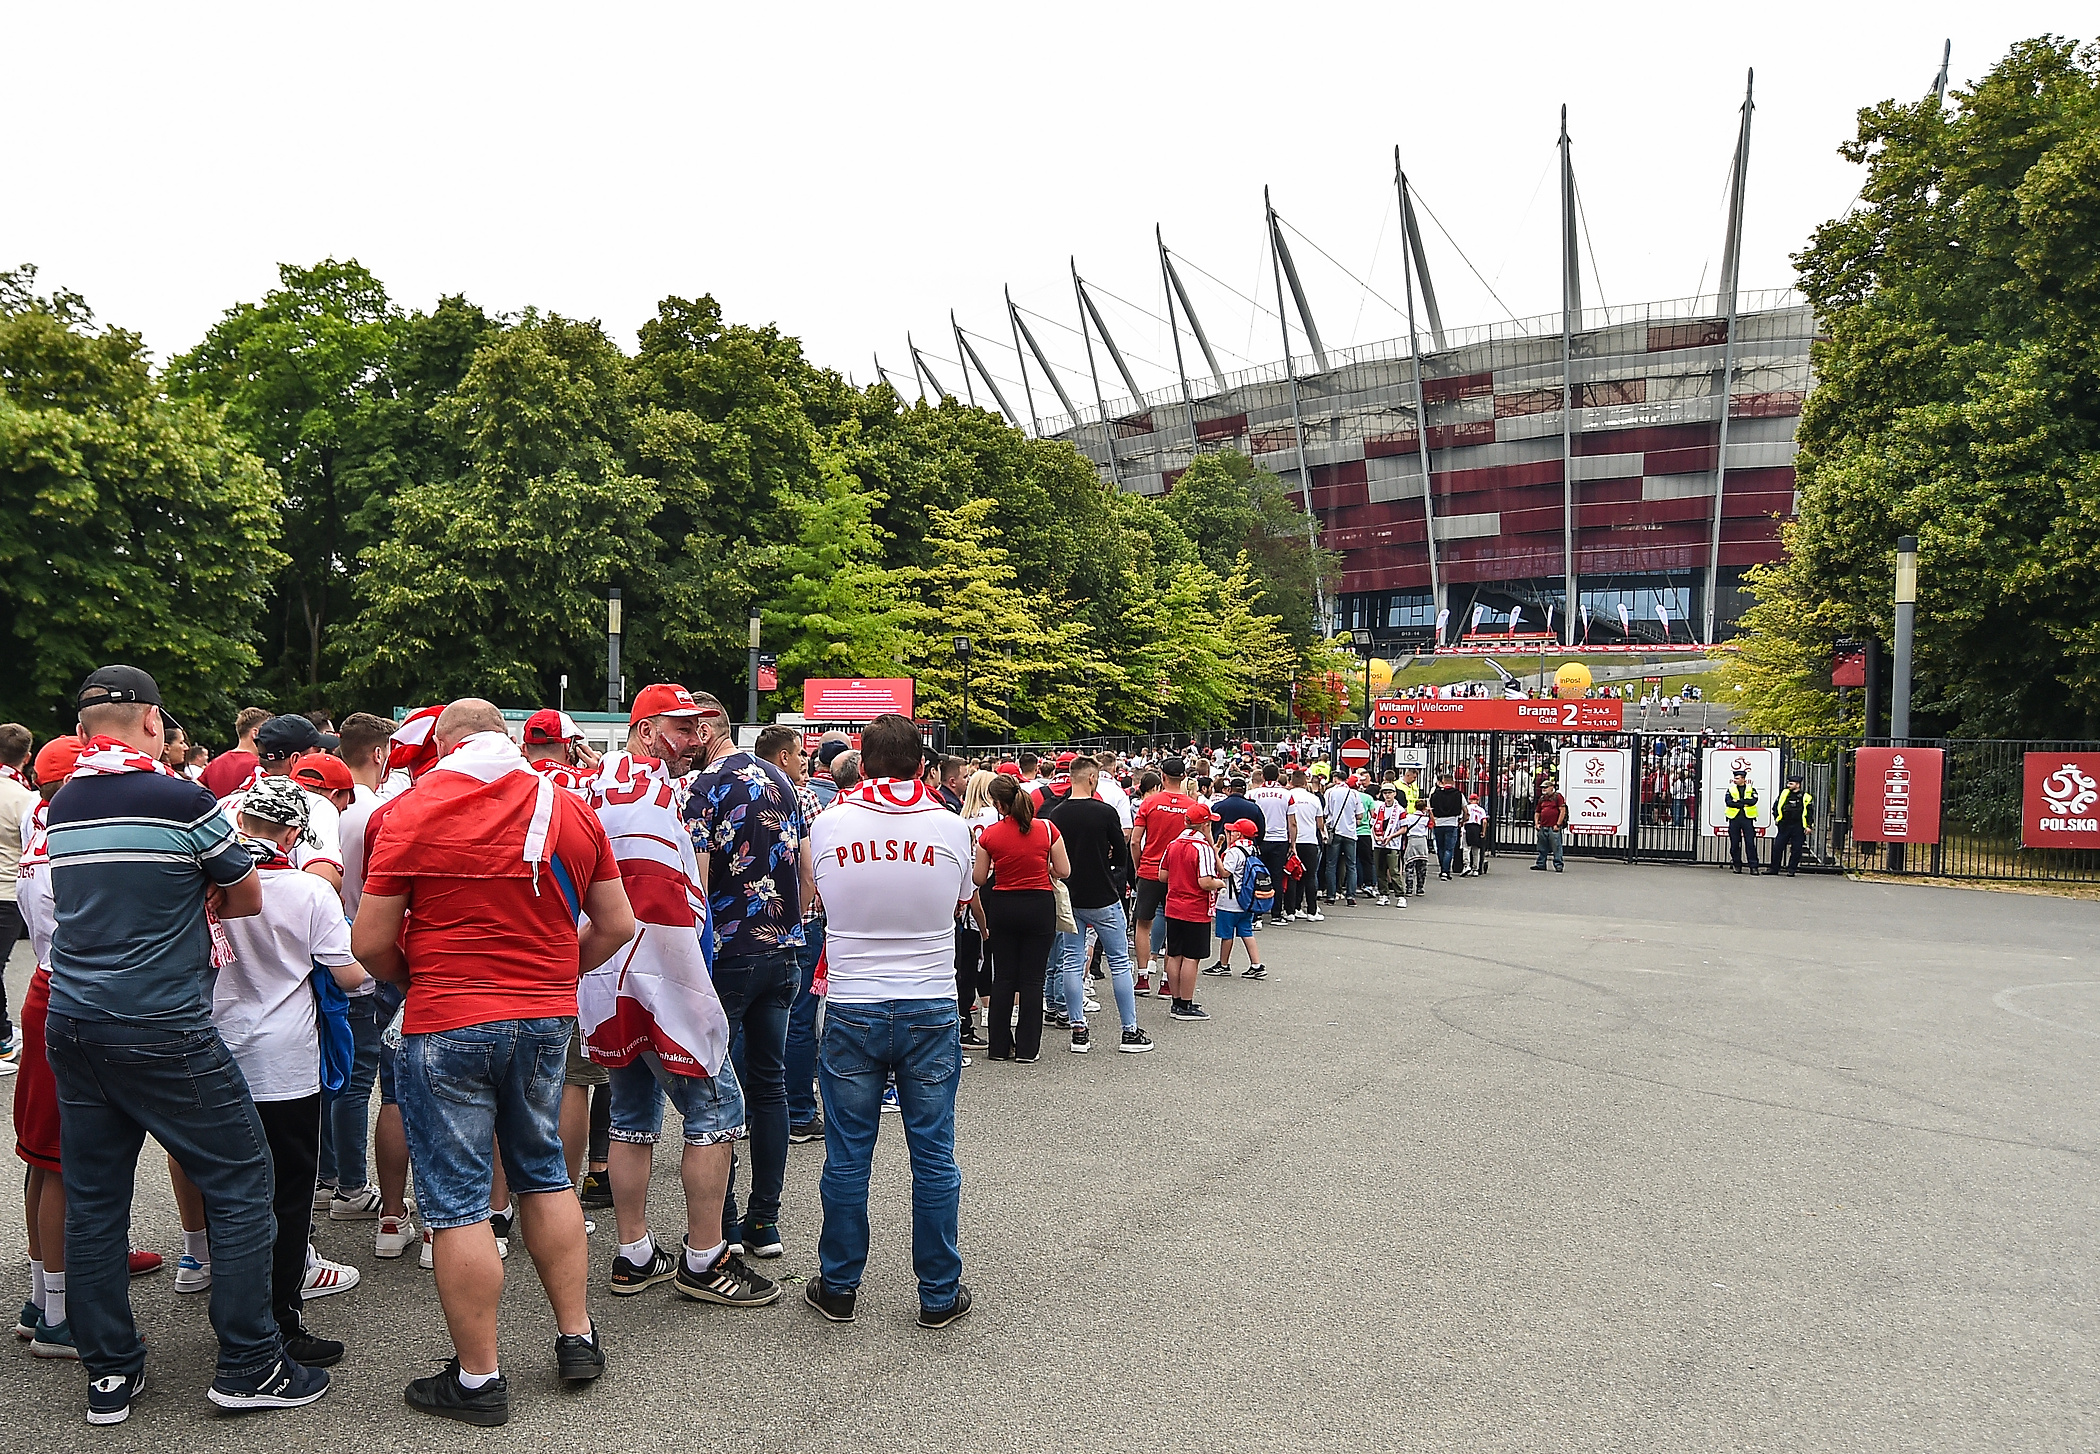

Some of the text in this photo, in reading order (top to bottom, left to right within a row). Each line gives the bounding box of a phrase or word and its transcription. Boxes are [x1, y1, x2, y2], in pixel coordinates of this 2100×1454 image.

[1379, 702, 1464, 714] Witamy Welcome
[1518, 705, 1558, 716] Brama
[1538, 716, 1558, 724] Gate
[1561, 703, 1578, 726] 2
[1257, 791, 1283, 799] POLSKA
[1156, 804, 1188, 814] POLSKA
[2039, 818, 2099, 832] POLSKA
[835, 839, 935, 868] POLSKA
[612, 1273, 629, 1282] adidas
[272, 1378, 290, 1396] FILA
